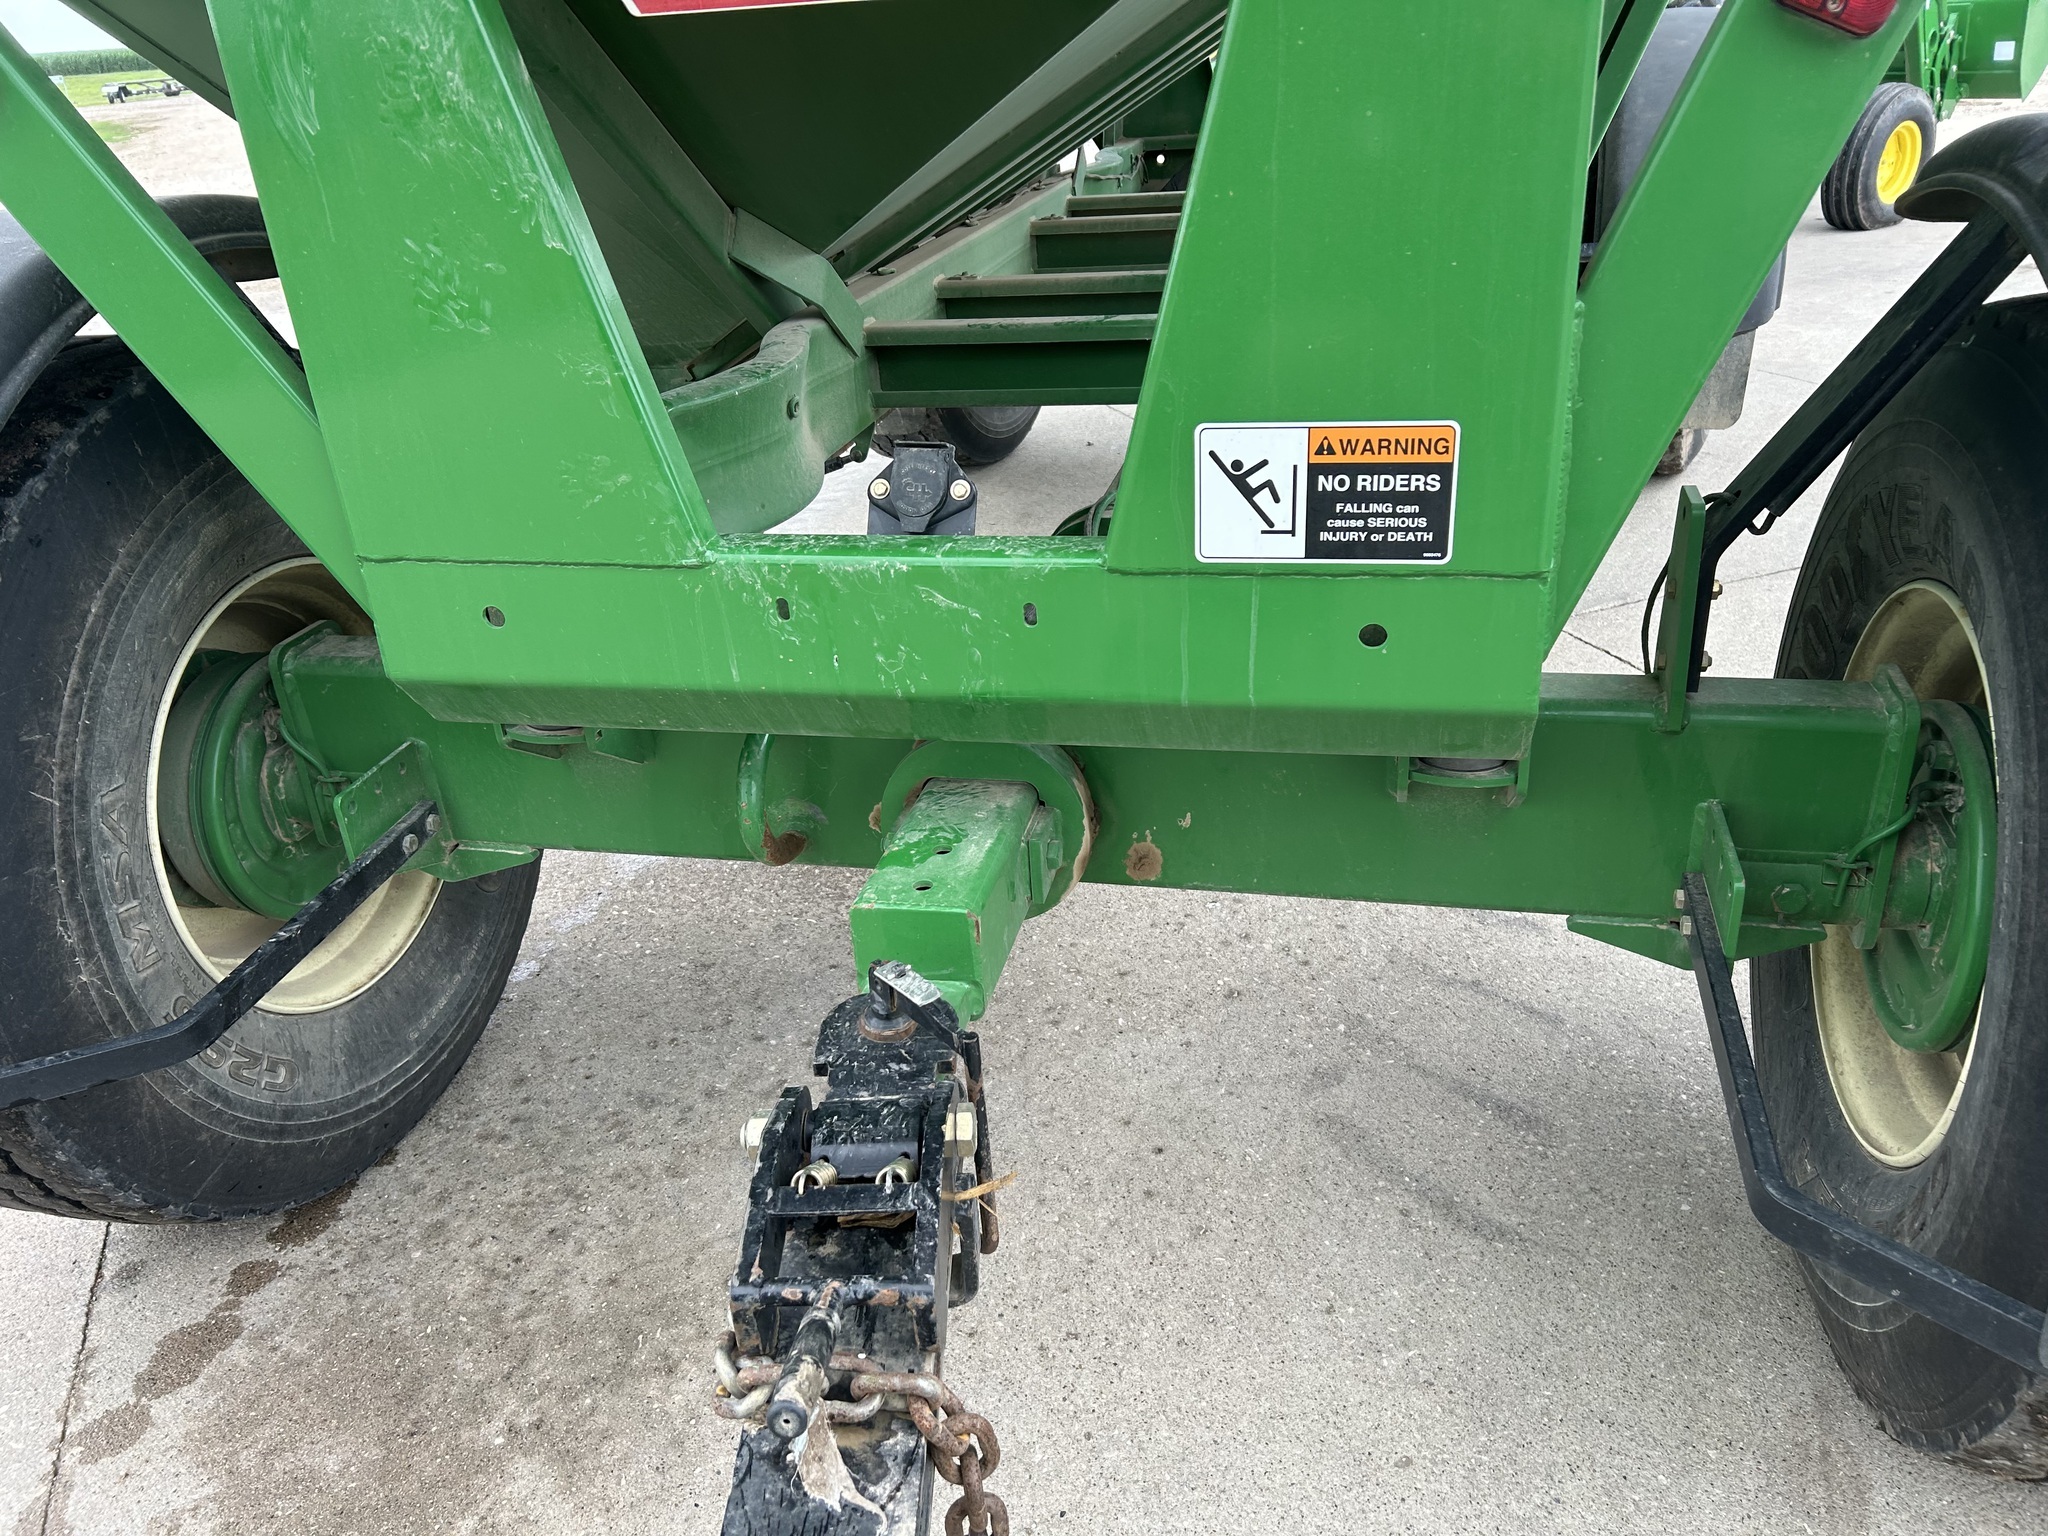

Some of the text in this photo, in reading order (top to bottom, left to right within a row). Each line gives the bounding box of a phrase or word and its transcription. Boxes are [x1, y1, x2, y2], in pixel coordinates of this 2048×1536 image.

[1339, 438, 1450, 455] WARNING
[1317, 474, 1441, 492] NO RIDERS
[1335, 503, 1420, 513] FALLING can
[1326, 517, 1428, 528] cause SERIOUS
[1319, 531, 1433, 542] INJURY or DEATH
